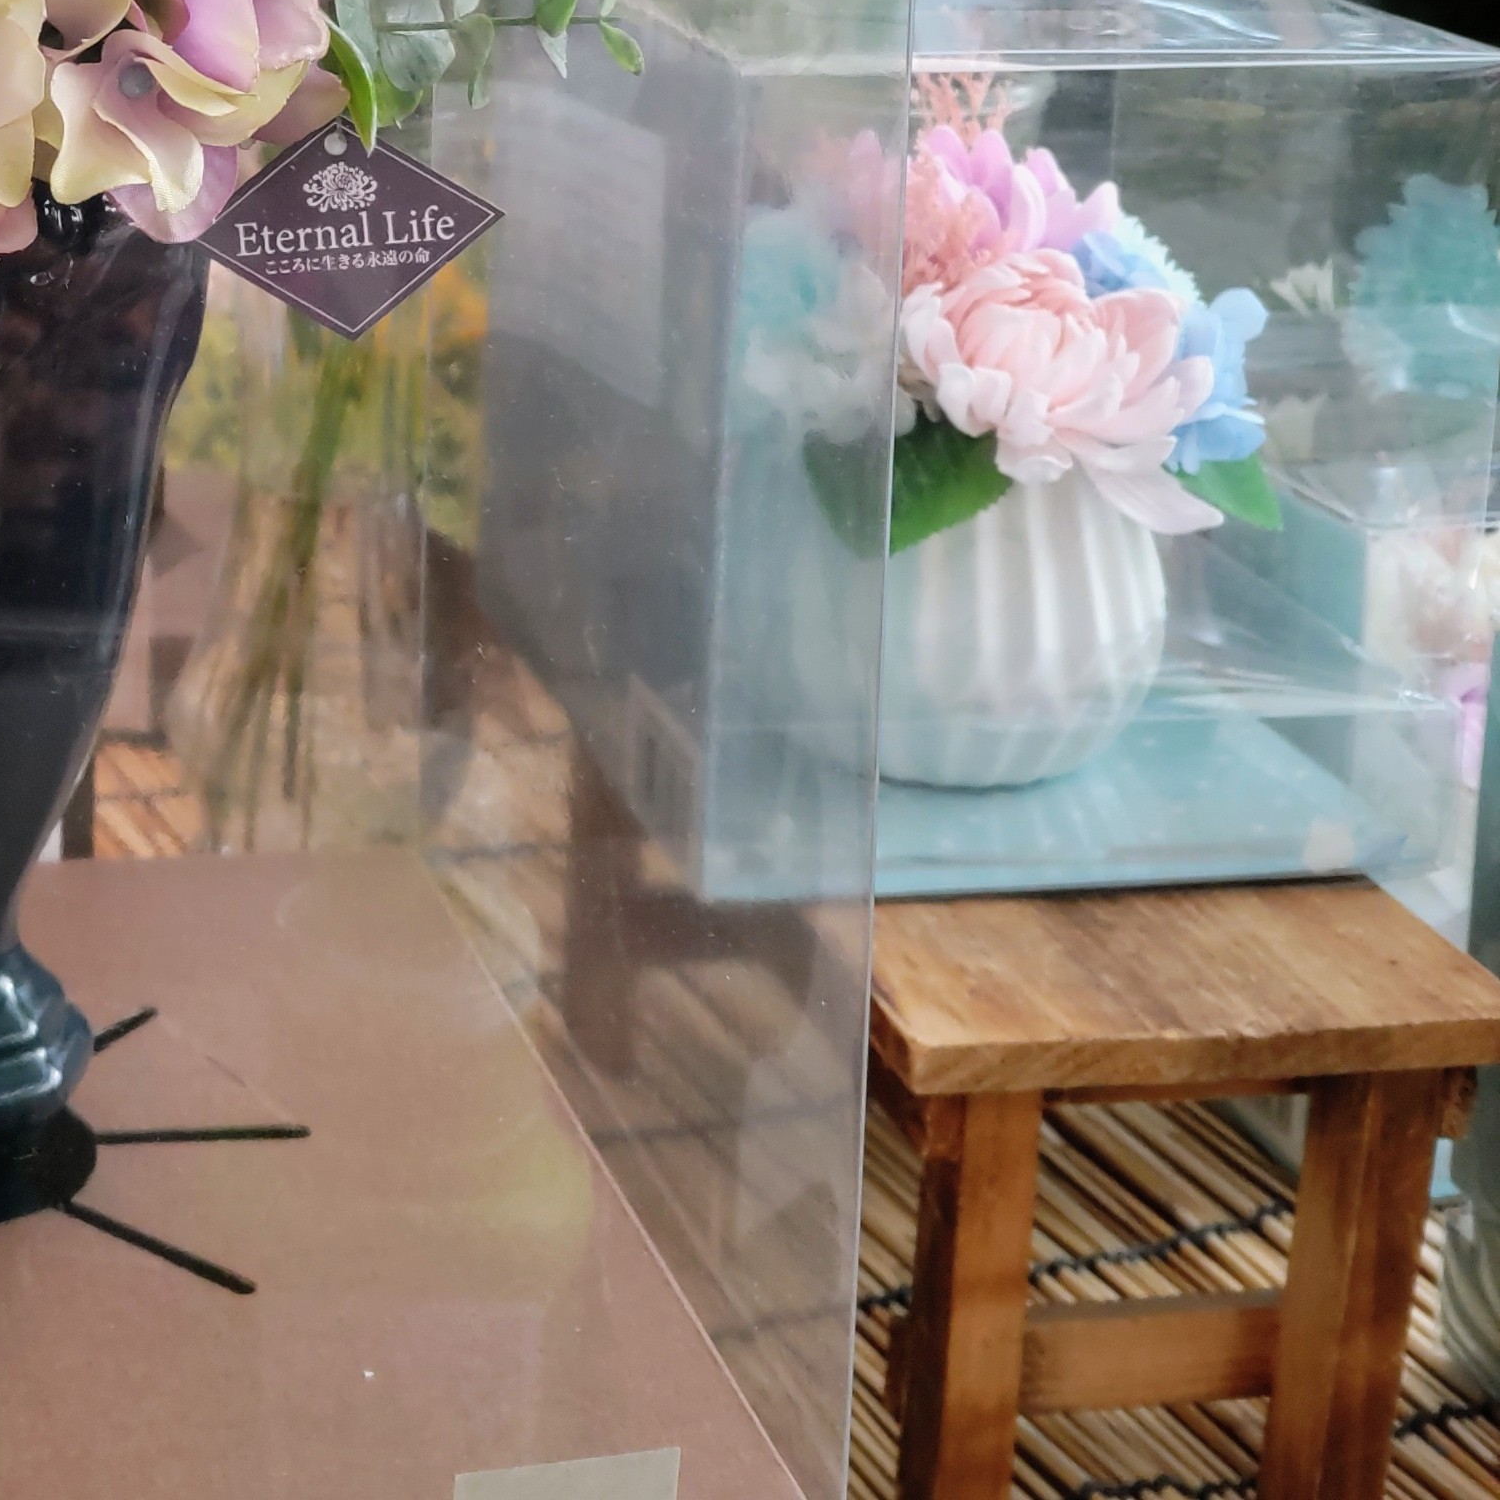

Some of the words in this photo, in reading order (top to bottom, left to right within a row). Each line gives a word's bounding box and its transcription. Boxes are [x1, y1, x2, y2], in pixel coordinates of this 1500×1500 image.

[233, 210, 374, 258] Eternal
[382, 204, 456, 245] Life
[264, 246, 431, 276] こころに生きる永遠の命
